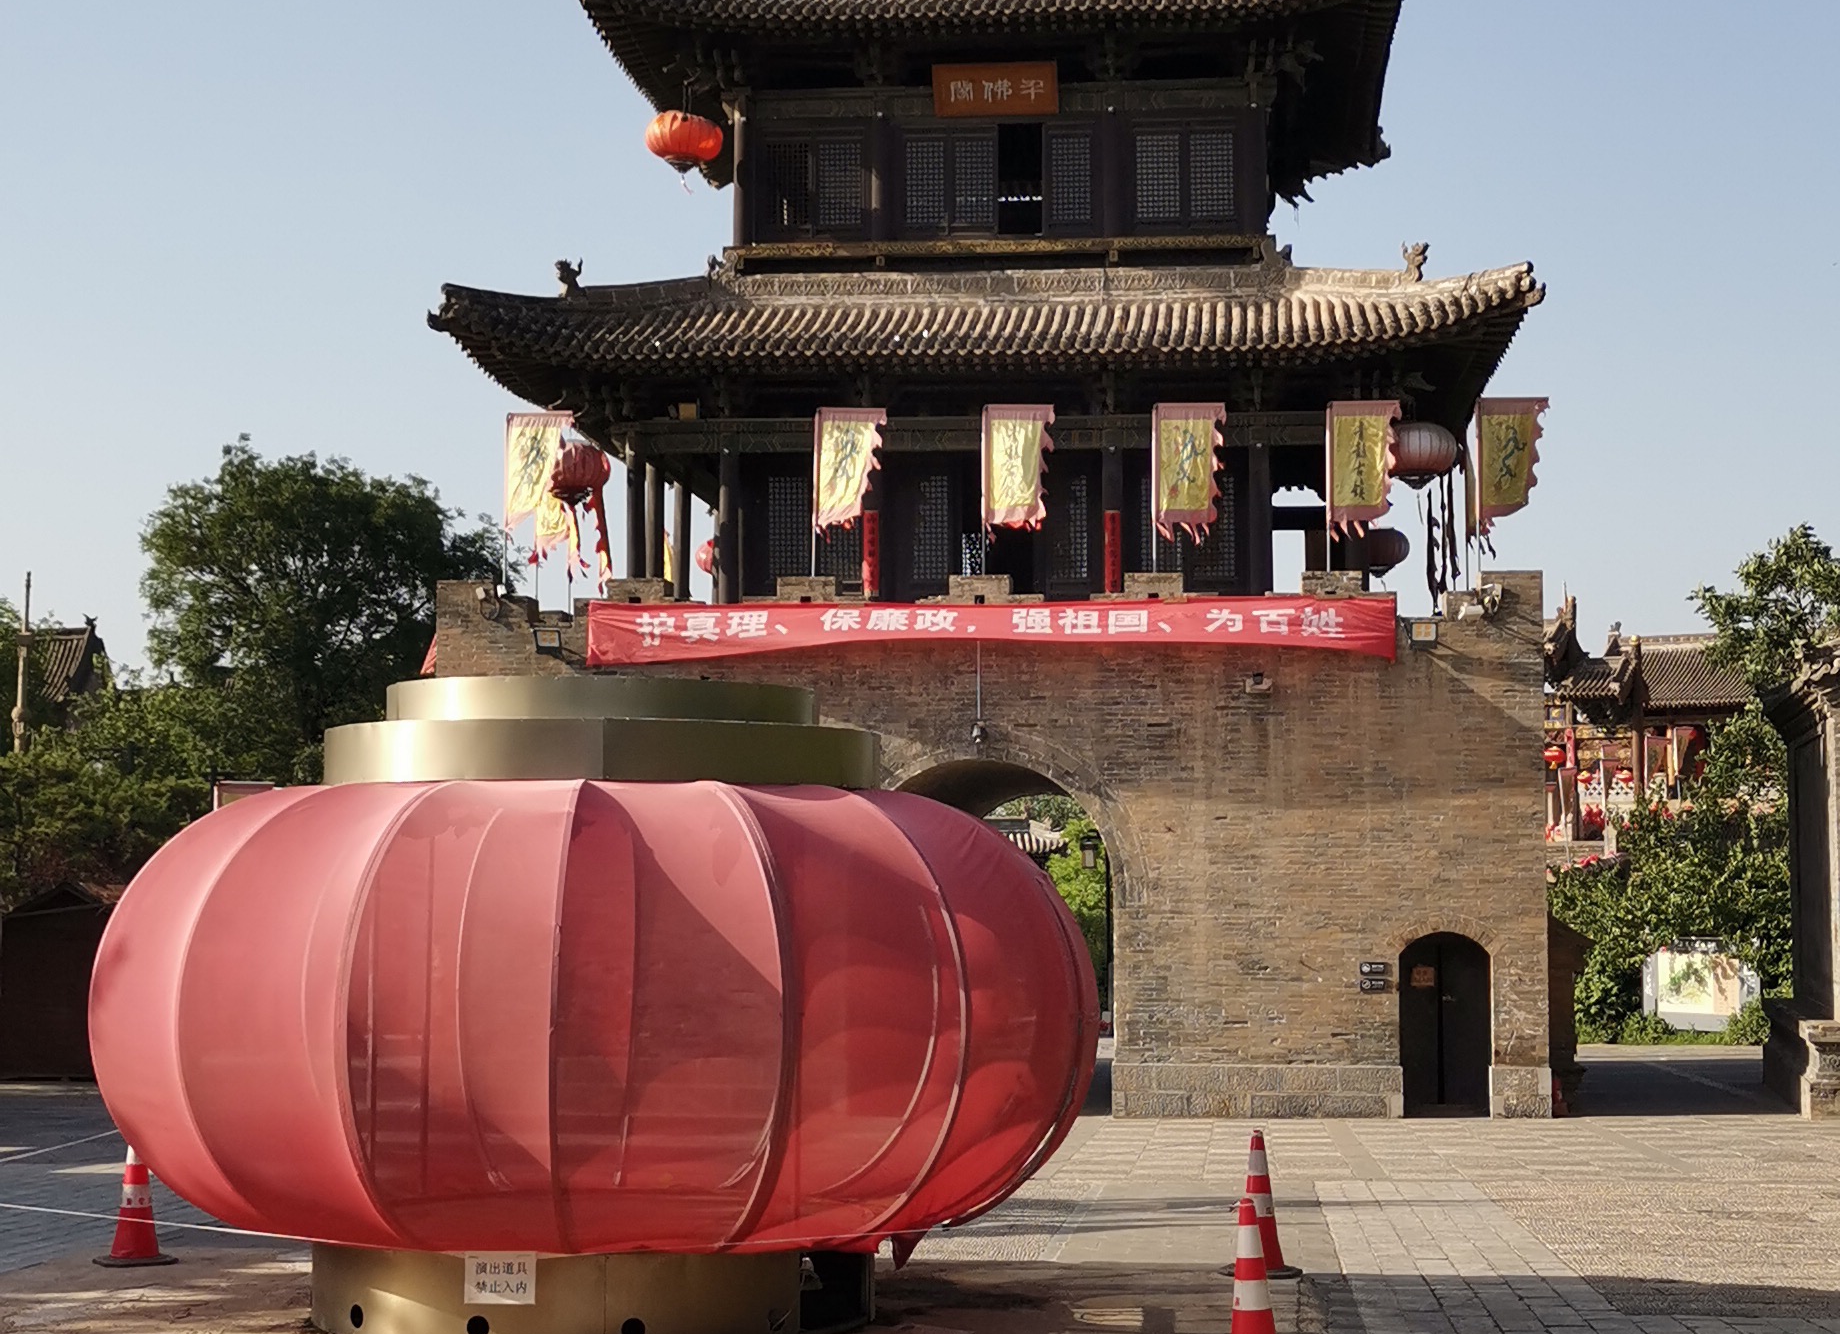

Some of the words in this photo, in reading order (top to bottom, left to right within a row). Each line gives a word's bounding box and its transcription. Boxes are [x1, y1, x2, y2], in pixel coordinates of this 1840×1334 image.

[475, 1261, 528, 1275] 演出道具
[475, 1280, 528, 1294] 禁止入内
